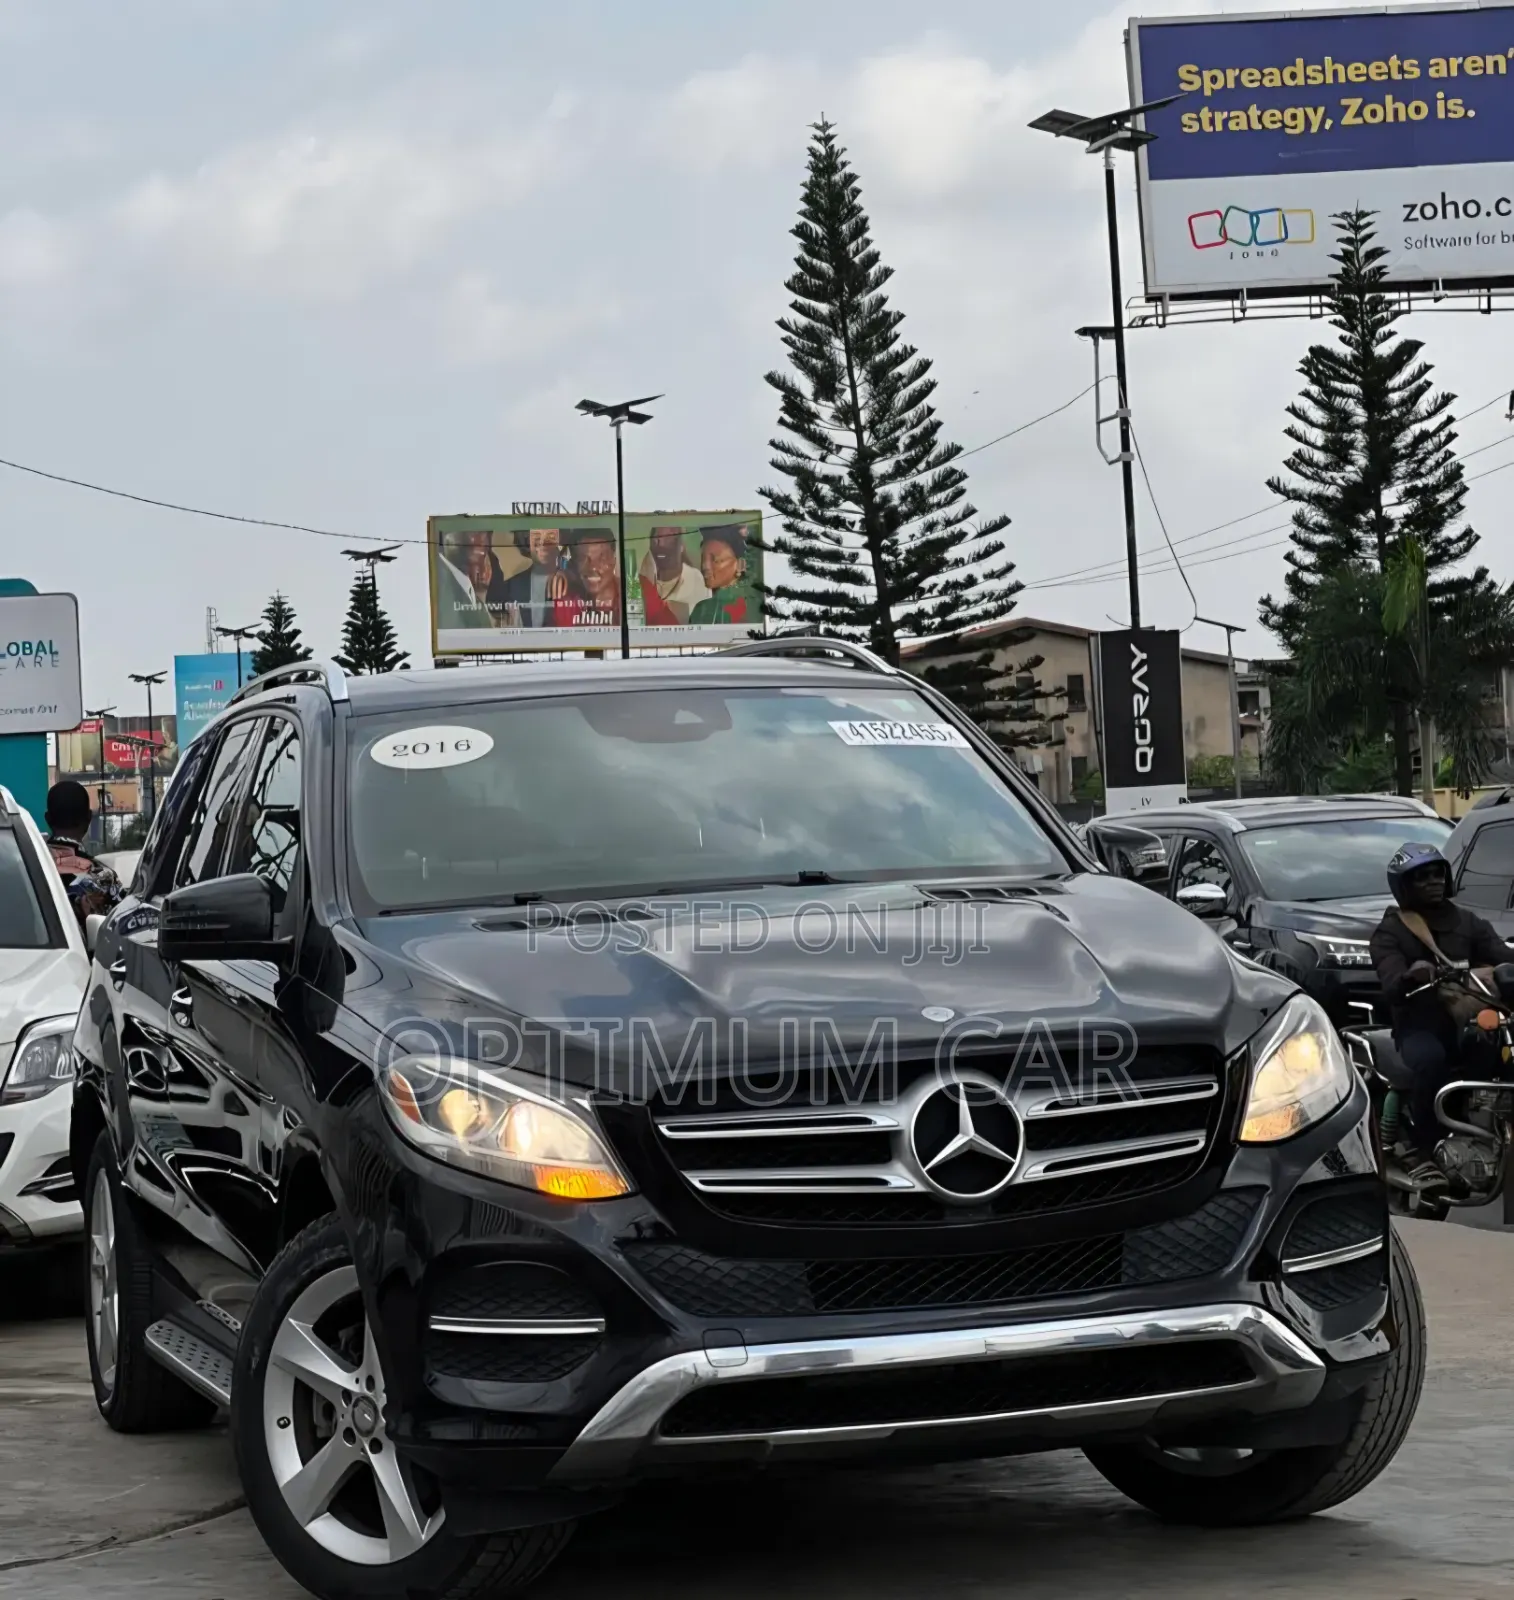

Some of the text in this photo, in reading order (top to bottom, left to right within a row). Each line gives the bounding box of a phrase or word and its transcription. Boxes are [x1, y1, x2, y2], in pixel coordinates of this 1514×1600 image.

[1178, 54, 1421, 96] Spreadsheets
[1181, 91, 1476, 134] strategy, Zoho is.
[1402, 191, 1512, 222] zoho.c
[0, 639, 59, 659] OBAL
[392, 739, 472, 757] 2016
